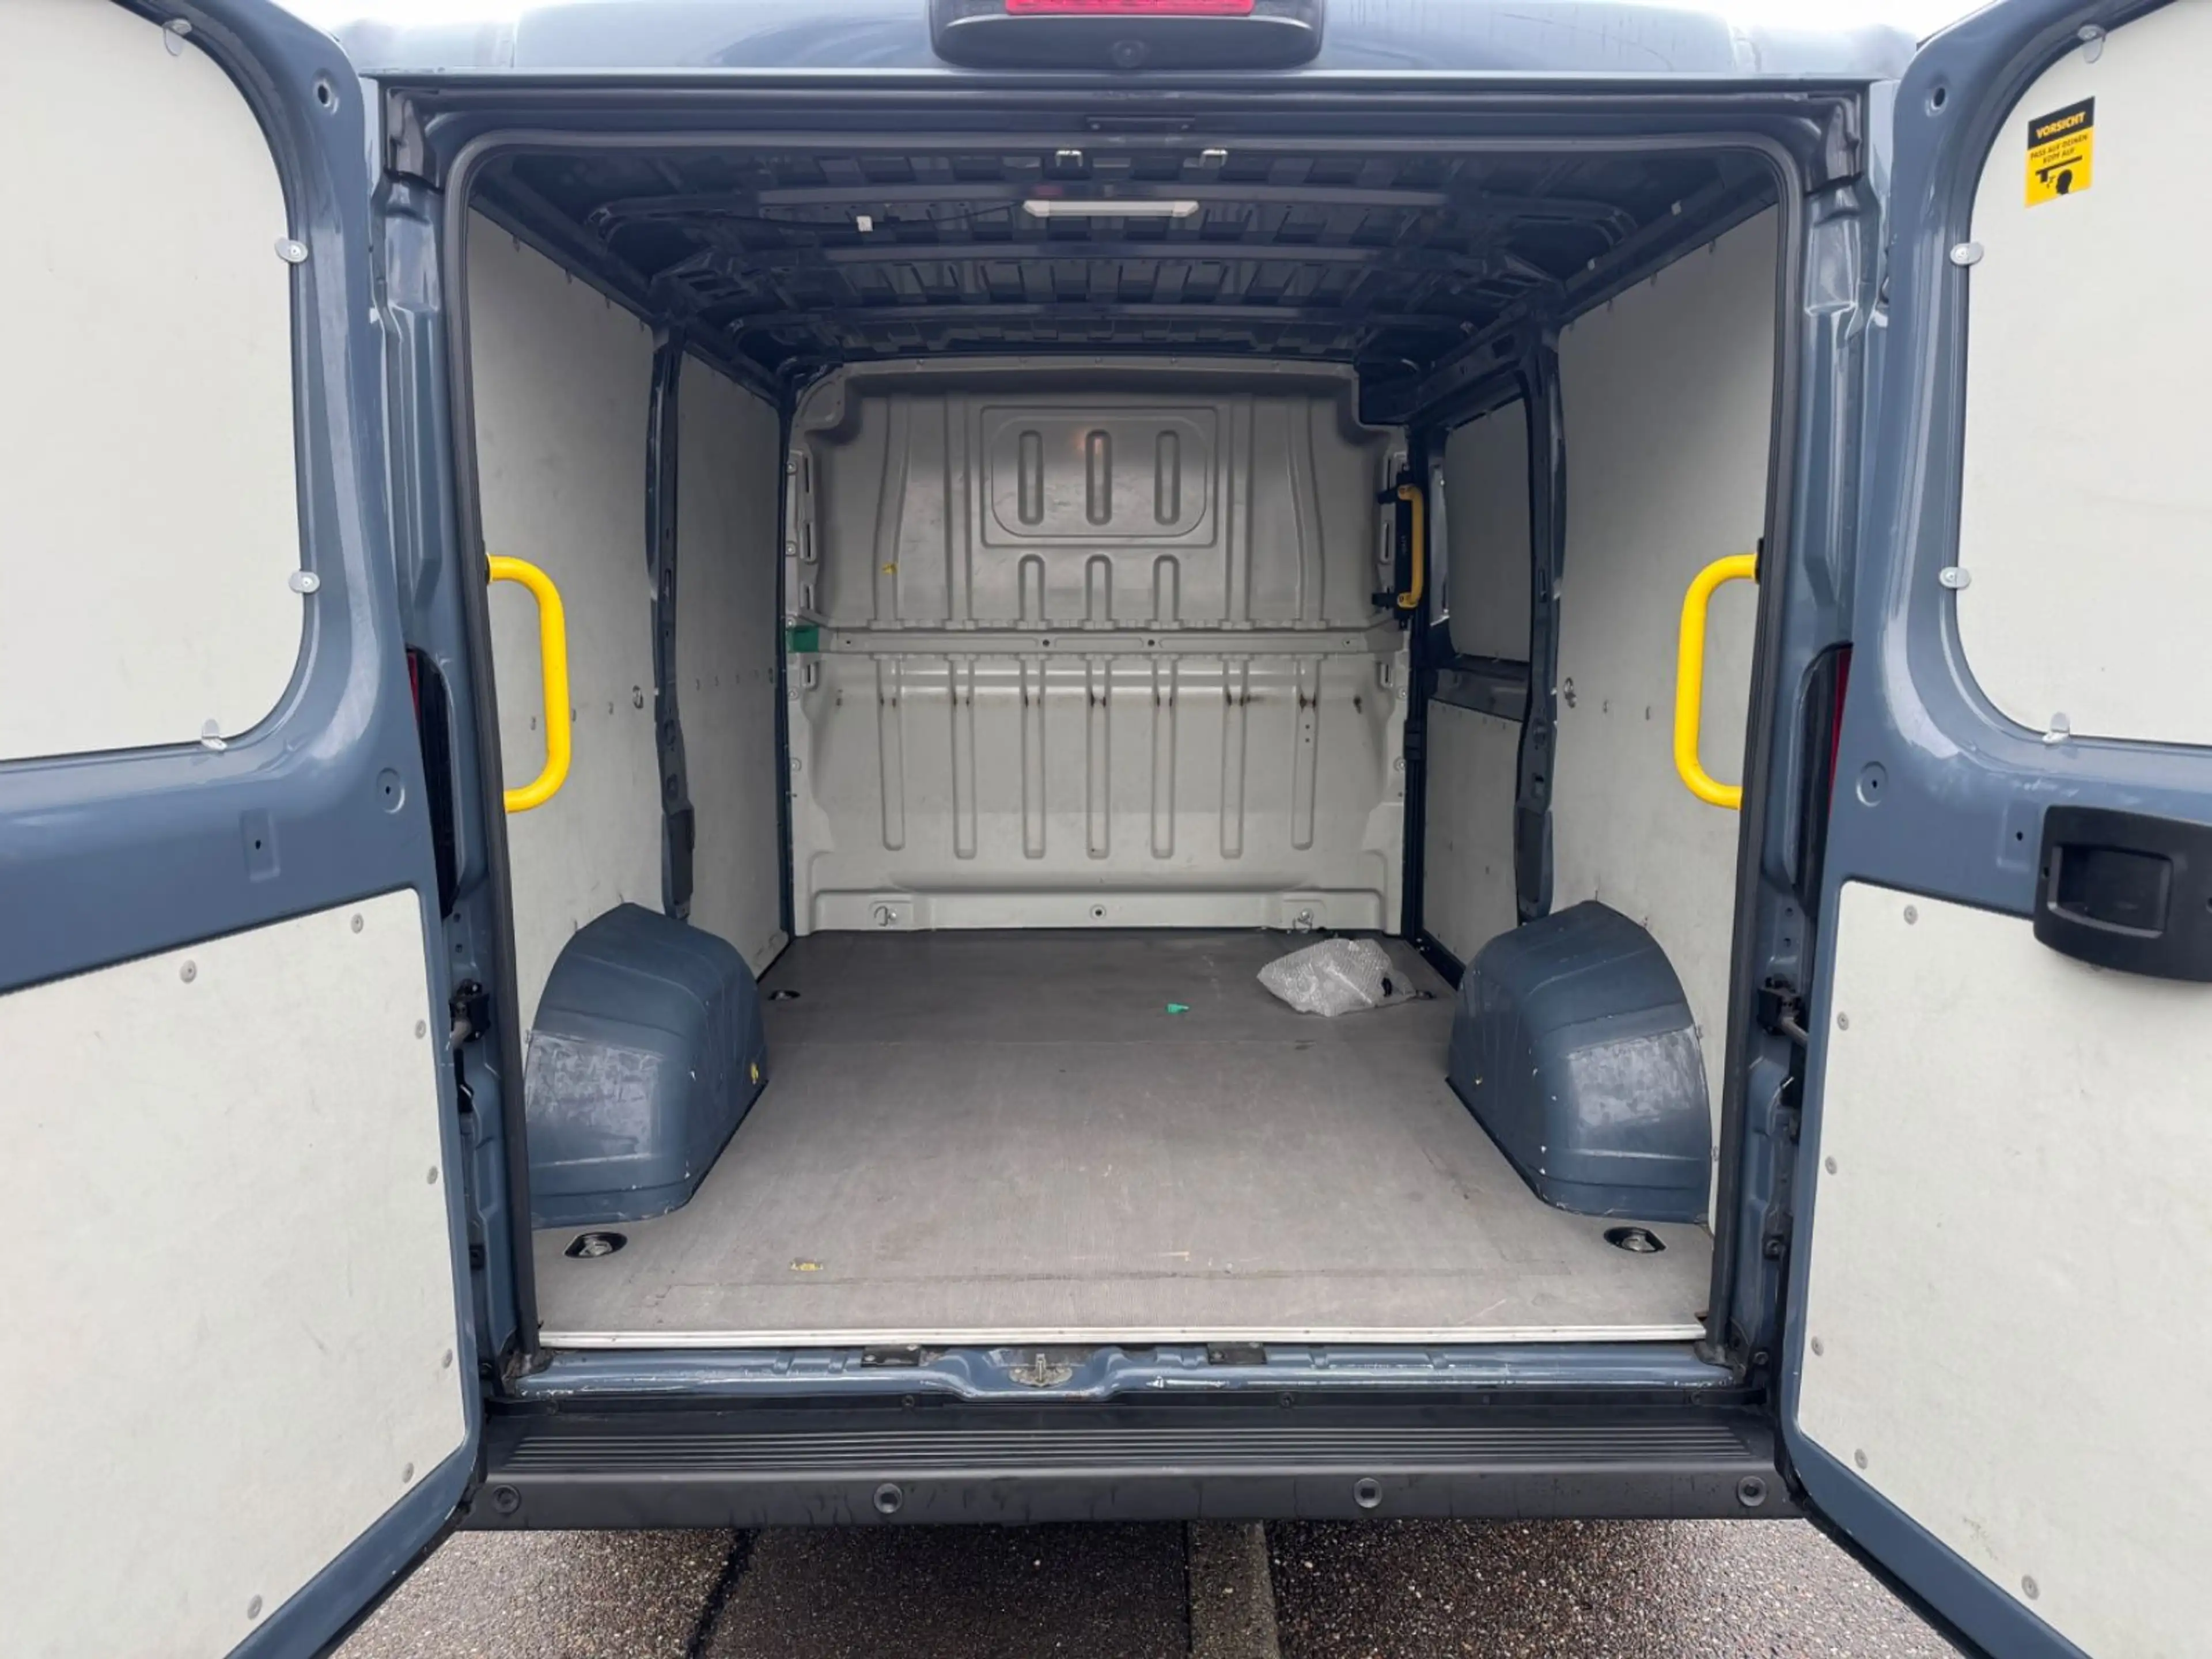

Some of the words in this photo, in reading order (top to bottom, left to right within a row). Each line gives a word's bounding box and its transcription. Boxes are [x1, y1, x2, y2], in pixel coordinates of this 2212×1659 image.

[2036, 111, 2086, 139] VORSICHT
[2031, 150, 2046, 161] PASS
[2048, 142, 2060, 153] AUF
[2062, 134, 2088, 147] DEINEN
[2062, 147, 2075, 156] AUF
